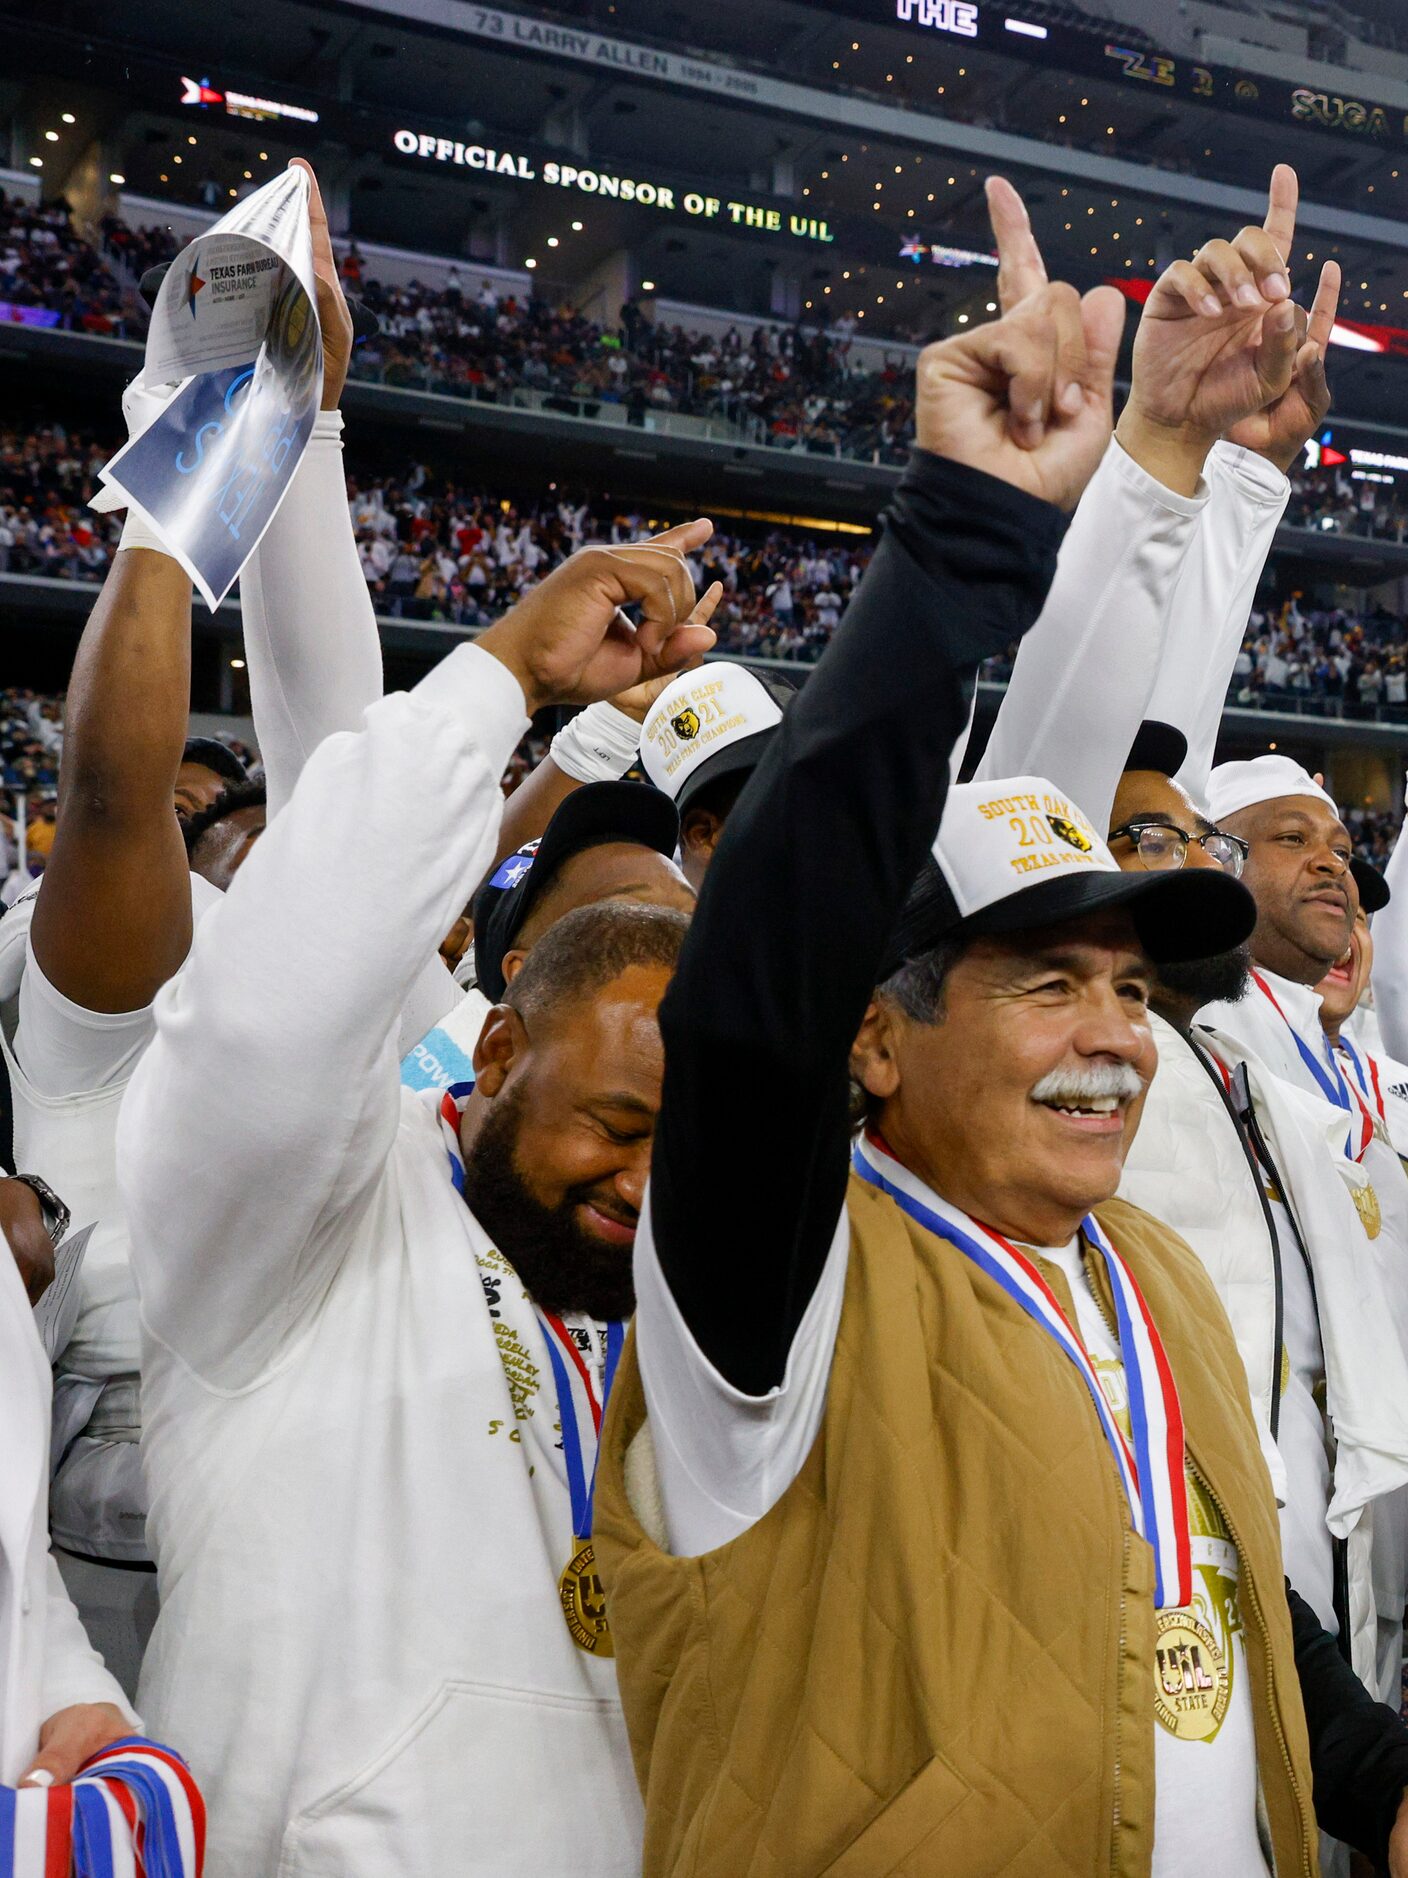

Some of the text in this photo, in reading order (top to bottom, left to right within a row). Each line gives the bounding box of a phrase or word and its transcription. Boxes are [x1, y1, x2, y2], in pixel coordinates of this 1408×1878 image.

[474, 11, 501, 32] 73
[513, 21, 589, 54] LARRY
[595, 42, 668, 75] ALLEN
[394, 130, 834, 242] OFFICIAL SPONSOR OF THE UIL
[210, 264, 236, 280] TEXAS
[211, 276, 257, 294] INSURANCE
[658, 697, 728, 758] 20 21
[977, 794, 1071, 821] SOUTH OAK
[1008, 815, 1053, 848] 20
[1009, 851, 1060, 875] TEXAS
[1155, 1644, 1214, 1697] UIL
[1174, 1693, 1209, 1713] STATE
